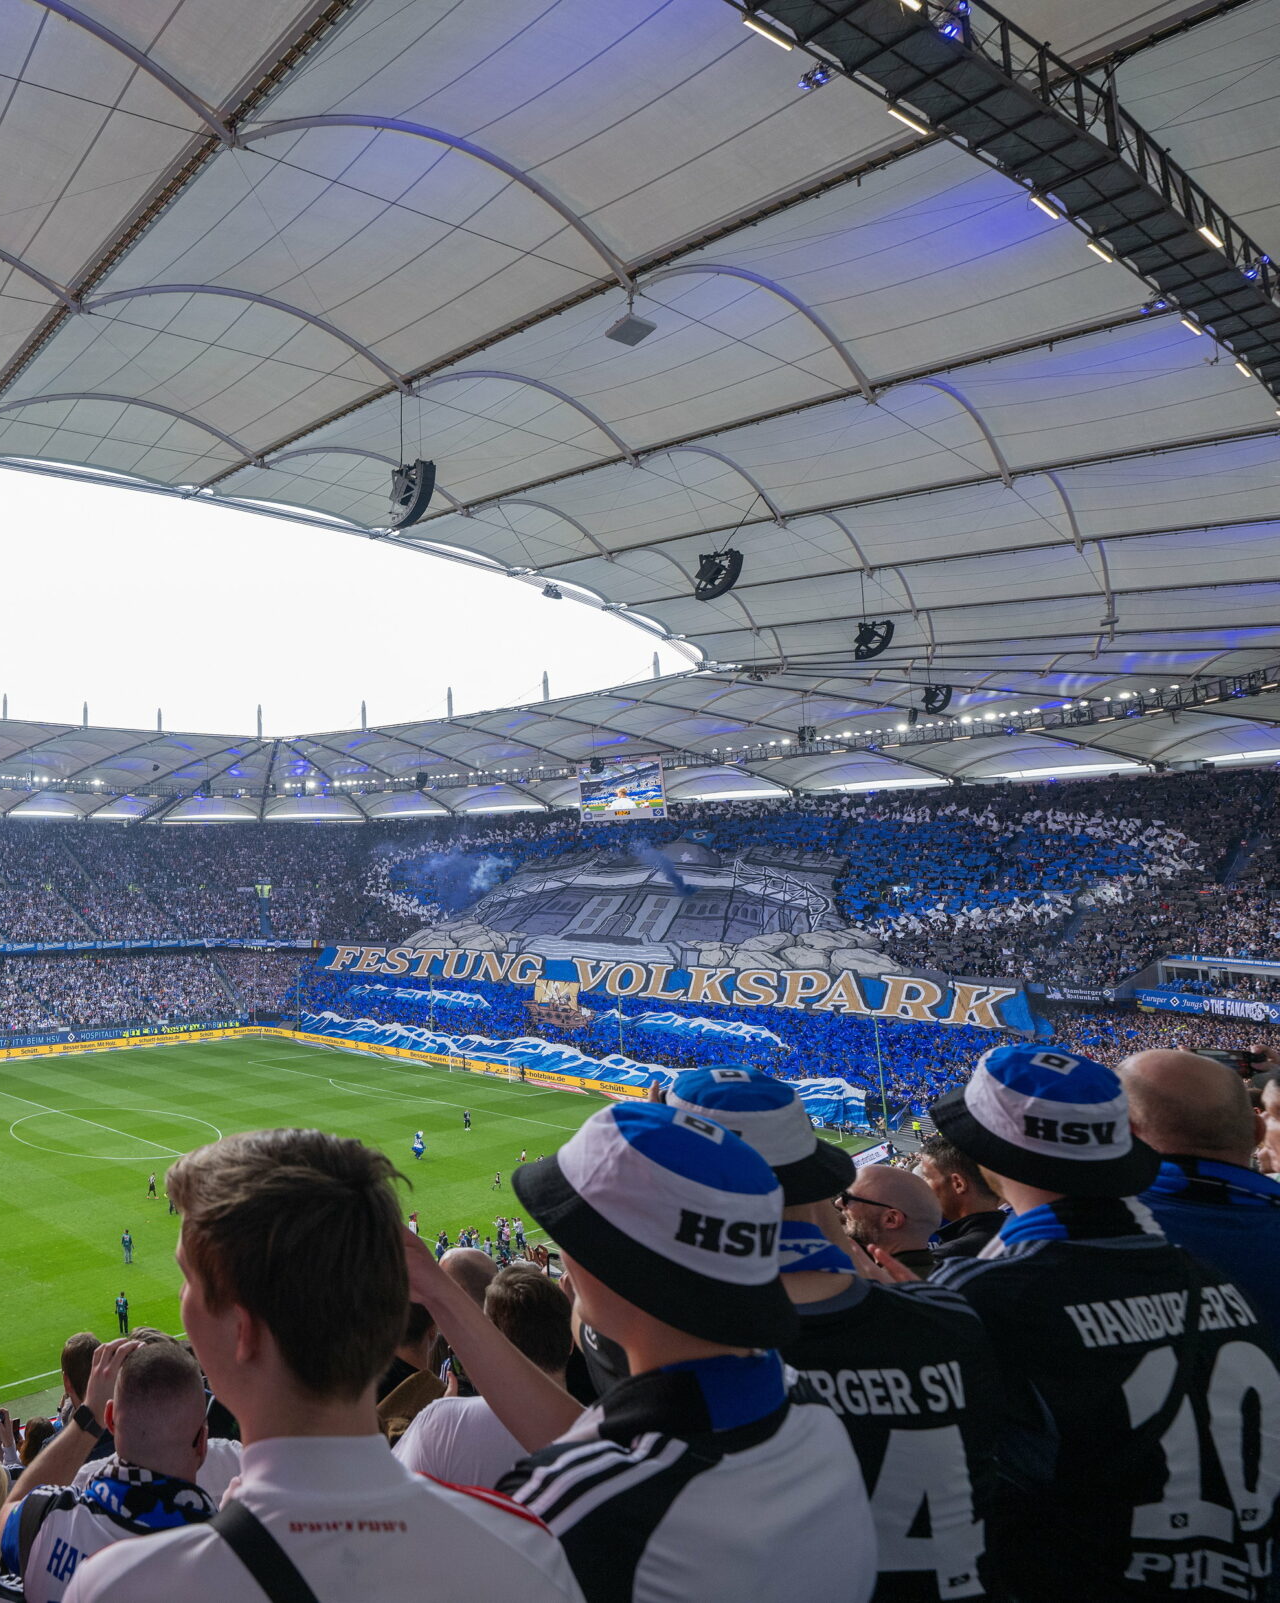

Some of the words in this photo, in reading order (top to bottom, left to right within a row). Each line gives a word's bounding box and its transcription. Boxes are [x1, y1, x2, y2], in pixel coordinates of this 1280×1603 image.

[325, 945, 543, 984] FESTUNG
[573, 957, 1017, 1029] VOLKSPARK
[1064, 988, 1101, 996] Hamburger
[1142, 994, 1167, 1004] Luruper
[1182, 999, 1202, 1008] Jungs
[1210, 999, 1224, 1014] THE
[27, 1036, 44, 1045] BEIM
[46, 1035, 62, 1044] HSV.
[410, 1052, 428, 1060] Besser
[430, 1055, 450, 1064] bauen.
[600, 1082, 628, 1093] Schütt.
[1023, 1116, 1116, 1146] HSV
[674, 1208, 776, 1257] HSV
[920, 1360, 966, 1413] SV
[1121, 1341, 1280, 1542] 10
[870, 1424, 986, 1601] 4
